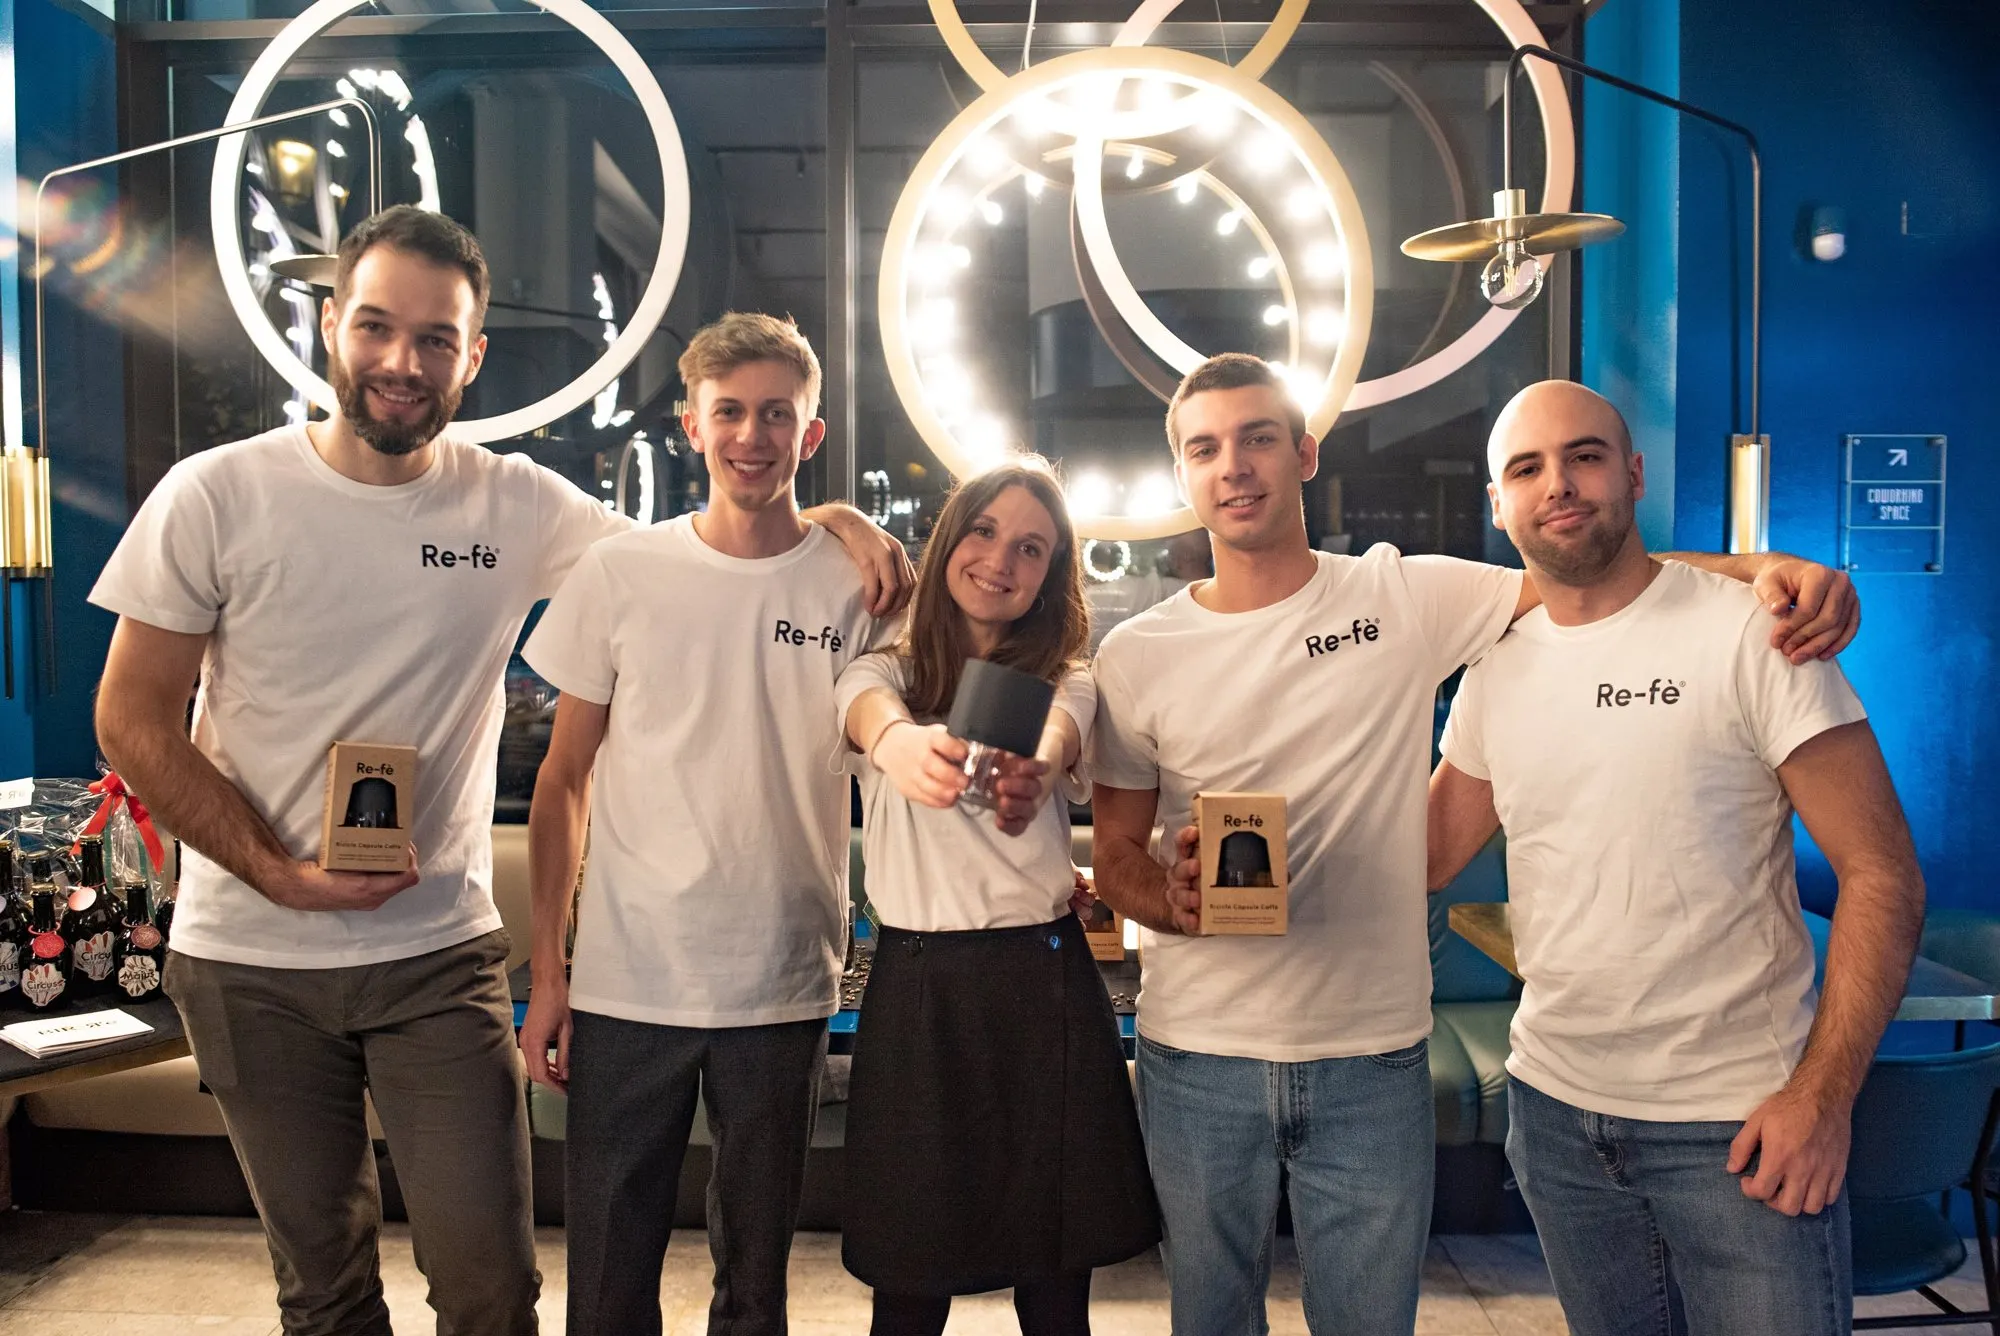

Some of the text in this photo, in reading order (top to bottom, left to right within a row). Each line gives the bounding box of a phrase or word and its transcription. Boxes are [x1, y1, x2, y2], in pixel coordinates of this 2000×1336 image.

[1867, 488, 1924, 503] COWORKING
[1879, 505, 1911, 520] SPACE
[81, 951, 111, 961] Circu
[26, 980, 59, 990] Circus
